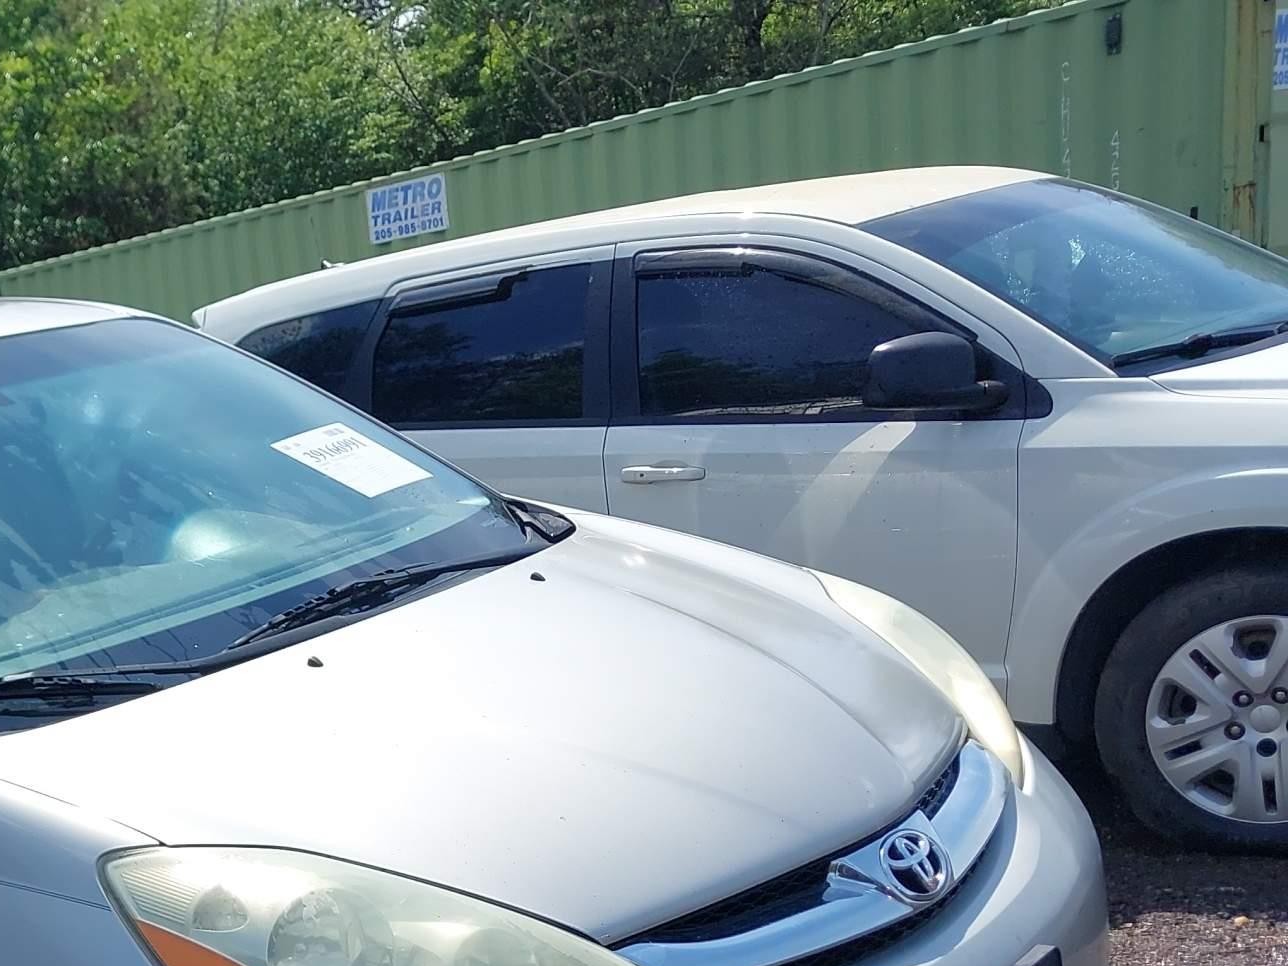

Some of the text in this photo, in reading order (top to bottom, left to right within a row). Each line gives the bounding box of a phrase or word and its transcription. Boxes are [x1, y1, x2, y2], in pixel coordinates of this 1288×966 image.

[371, 177, 442, 213] METRO
[371, 200, 442, 228] TRAILER
[302, 436, 368, 463] 39166991
